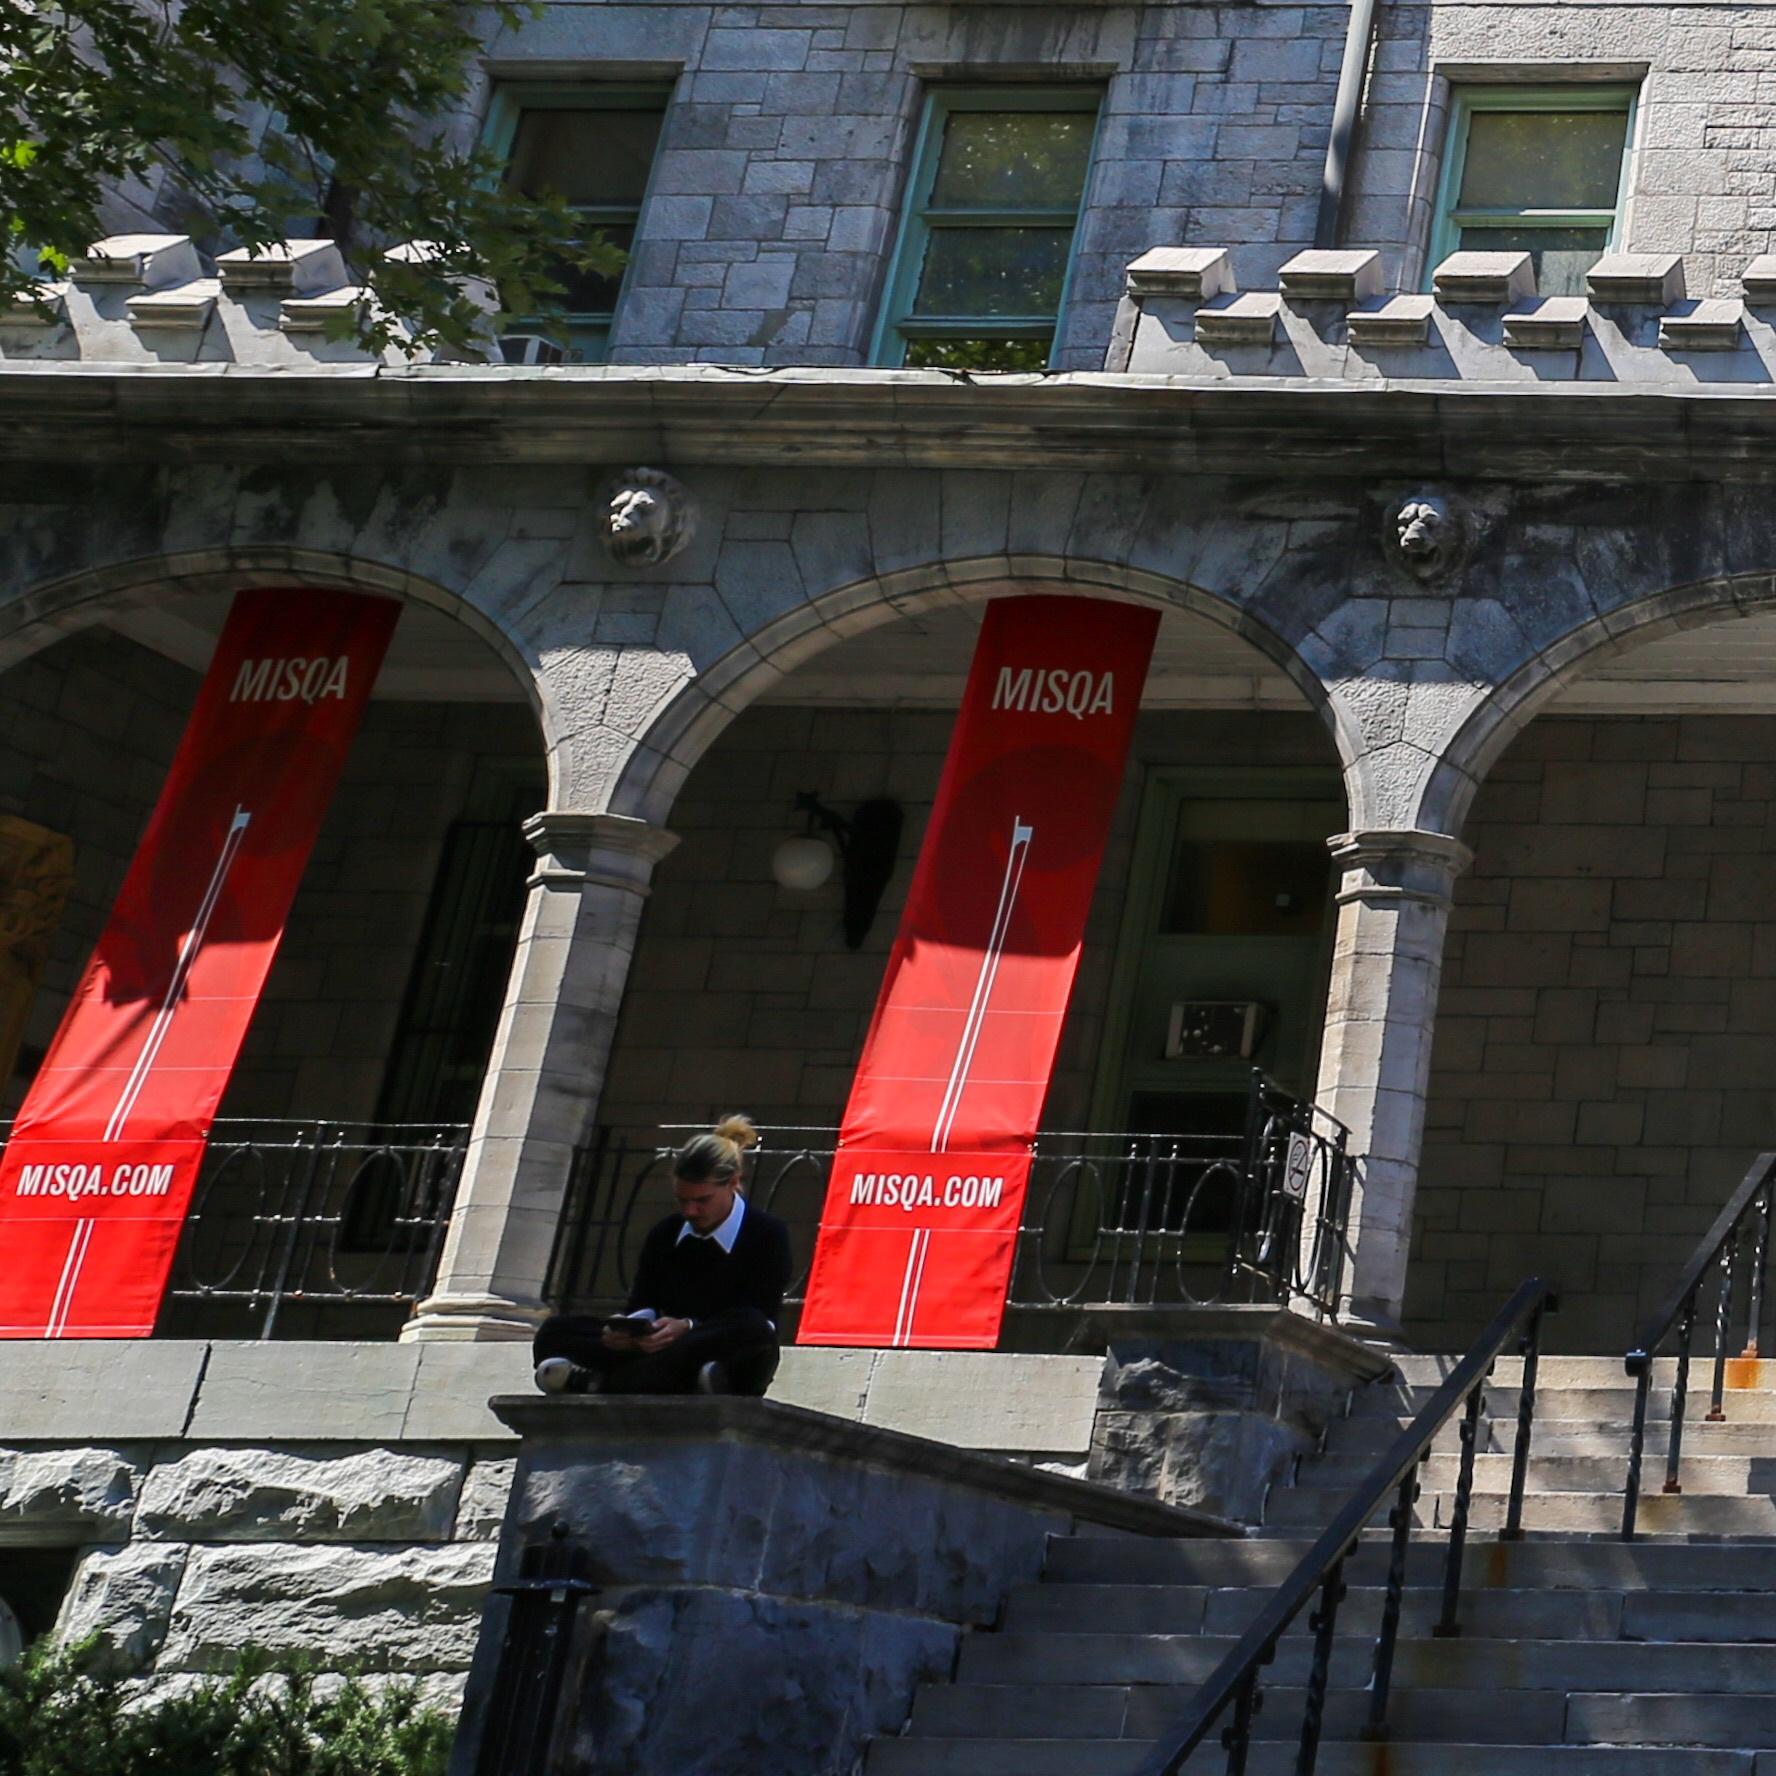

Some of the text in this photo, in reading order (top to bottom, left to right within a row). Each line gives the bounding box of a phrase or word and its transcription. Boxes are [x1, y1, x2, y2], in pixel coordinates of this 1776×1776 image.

[228, 655, 349, 705] MISQA
[991, 666, 1115, 721] MISQA
[16, 1163, 174, 1202] MISQA.COM
[849, 1172, 1004, 1211] MISQA.COM
